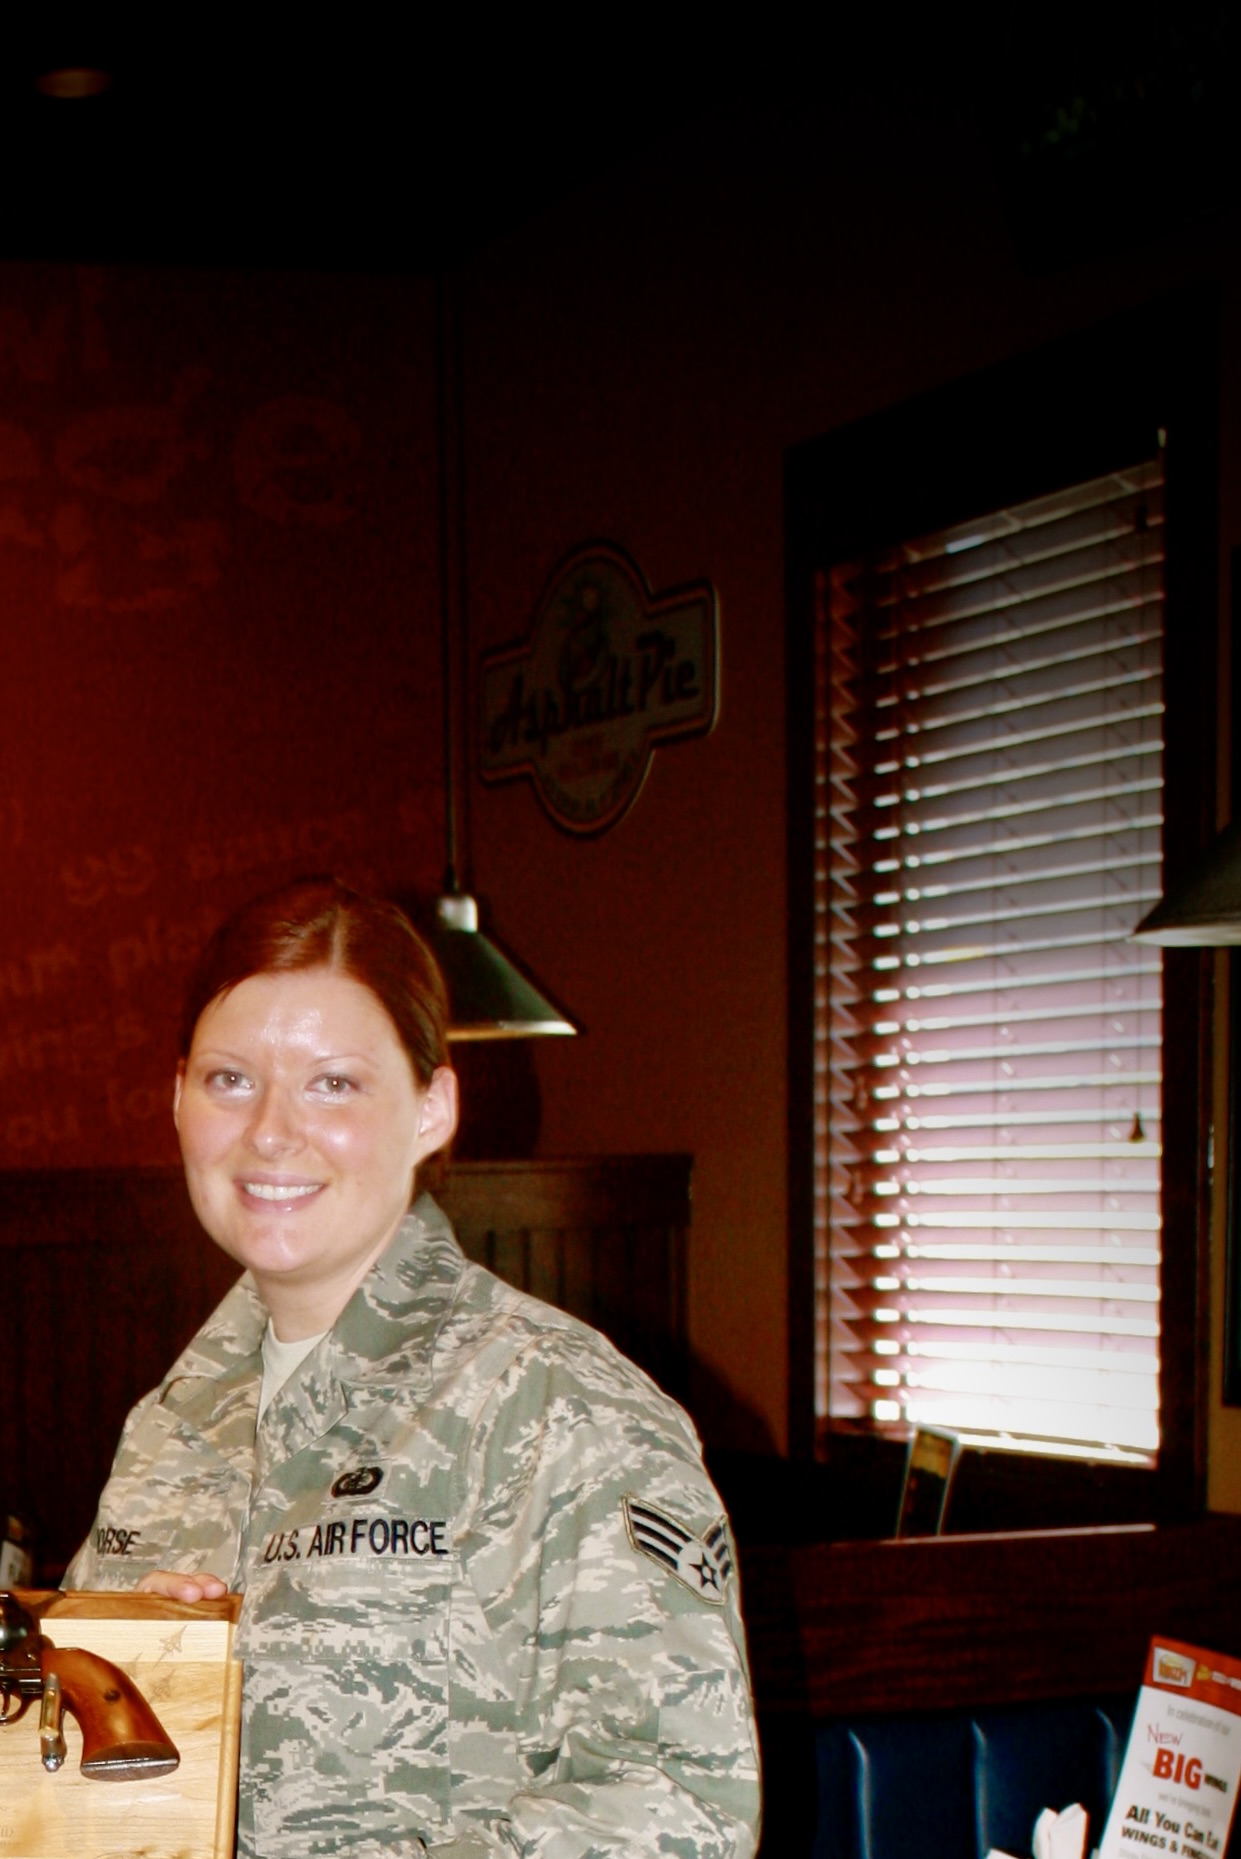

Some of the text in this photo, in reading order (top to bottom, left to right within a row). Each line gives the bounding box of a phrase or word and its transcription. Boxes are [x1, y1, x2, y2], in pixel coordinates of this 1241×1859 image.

[488, 630, 701, 757] Asphalt Pie
[263, 1518, 449, 1564] U.S. AIR FORCE
[1153, 1747, 1203, 1791] BIG
[1120, 1824, 1166, 1850] WINGS
[1169, 1838, 1178, 1854] &
[1126, 1804, 1150, 1825] All
[1155, 1810, 1180, 1835] You
[1183, 1821, 1206, 1844] Can
